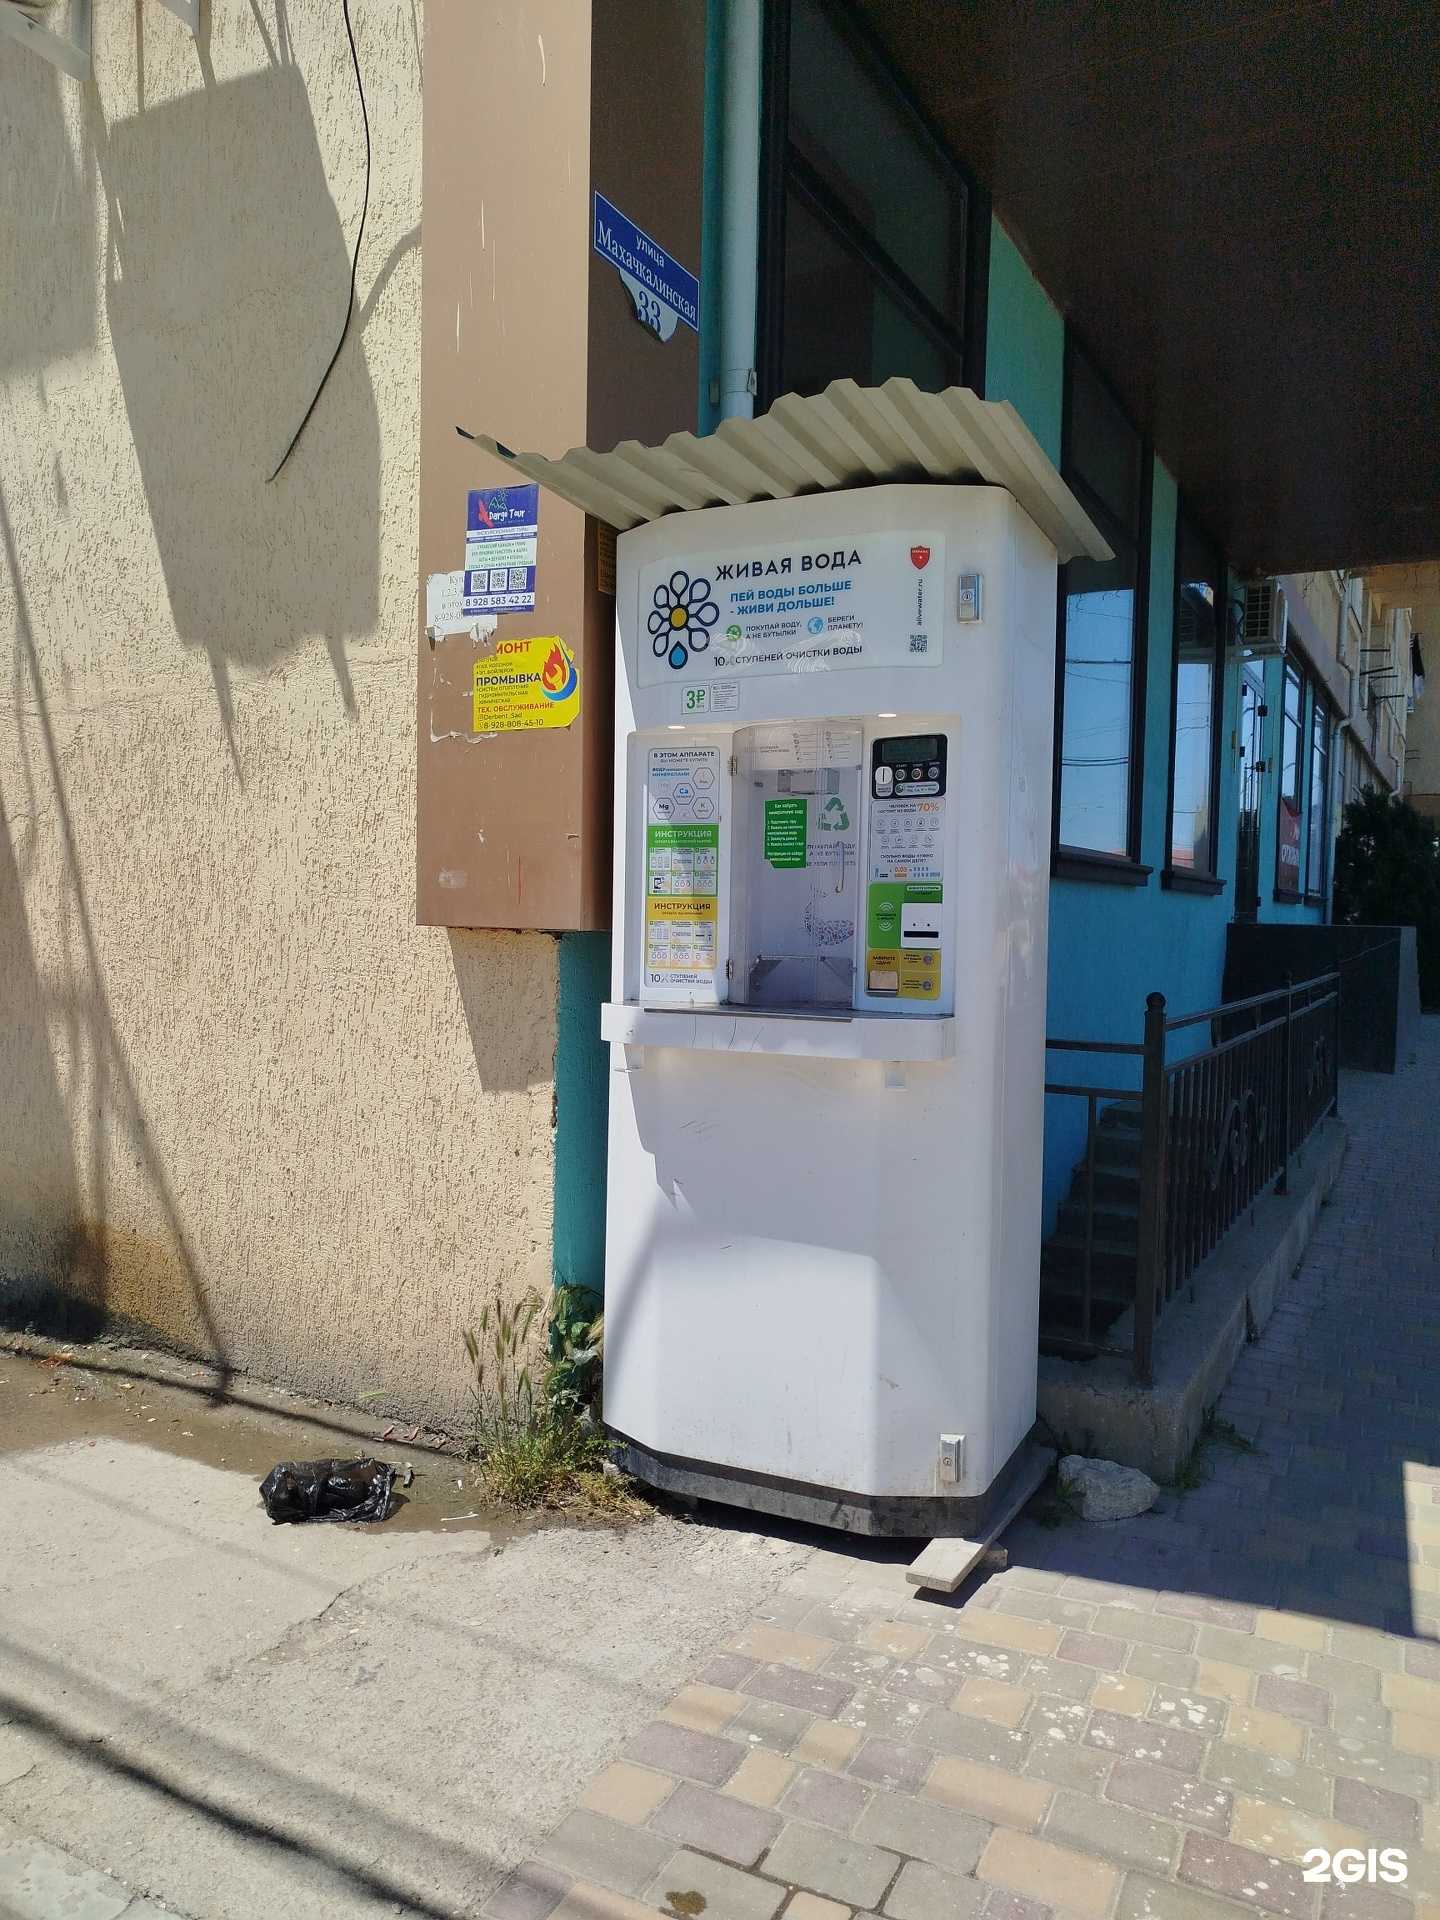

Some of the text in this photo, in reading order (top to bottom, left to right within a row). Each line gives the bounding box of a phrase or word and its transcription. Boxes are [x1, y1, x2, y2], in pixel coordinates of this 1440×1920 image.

[636, 235, 665, 268] улица
[598, 219, 696, 321] Махачкалинская
[509, 508, 526, 519] Tour
[715, 549, 862, 581] ЖИВАЯ ВОДА
[730, 580, 852, 603] ПЕЙ ВОДЫ БОЛЬШЕ
[465, 594, 532, 606] 8 928 583 42 22
[737, 603, 774, 615] ЖИВИ
[777, 596, 835, 613] ДОЛЬШЕ!
[827, 614, 855, 623] БЕРЕГИ
[746, 622, 780, 632] ПОКУПАЙ
[827, 622, 864, 631] ПЛАНЕТУ!
[762, 629, 797, 638] БУТЫЛКИ
[735, 652, 783, 664] СТУПЕНЕЙ
[785, 648, 830, 660] ОЧИСТКИ
[832, 645, 863, 656] ВОДЫ
[476, 672, 542, 686] ПРОМЫВКА
[478, 702, 554, 714] ТЕХ. ОБСЛУЖИВАНИЕ
[655, 830, 712, 838] ИНСТРУКЦИЯ
[654, 902, 711, 911] ИНСТРУКЦИЯ
